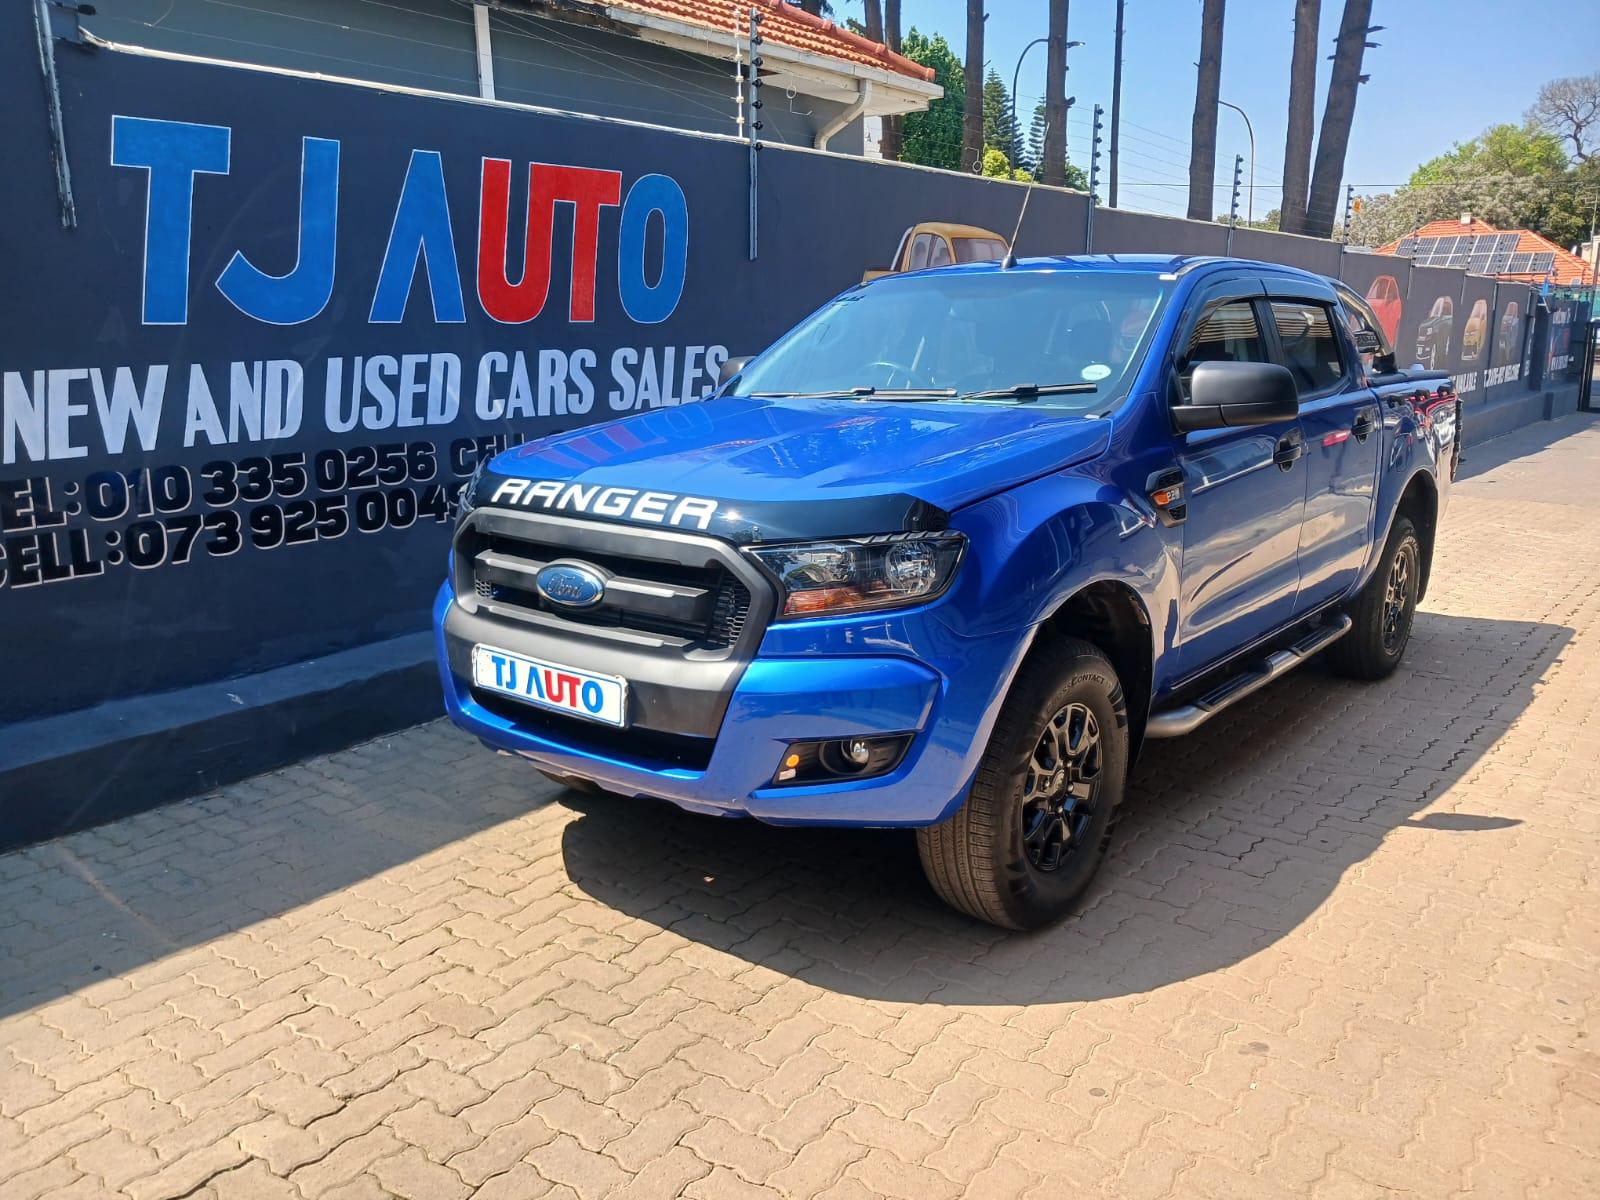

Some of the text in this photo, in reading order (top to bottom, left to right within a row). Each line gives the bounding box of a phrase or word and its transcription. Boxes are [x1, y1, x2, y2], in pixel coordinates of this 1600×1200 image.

[110, 115, 690, 325] TJ AUTO
[3, 344, 729, 465] NEW AND USED CARS SALES
[0, 463, 192, 534] EL:010
[201, 451, 308, 508] 335
[315, 440, 438, 493] 0256
[491, 478, 719, 530] RANGER
[250, 494, 350, 550] 925
[547, 573, 585, 600] Ford
[491, 655, 604, 714] TJ AUTO
